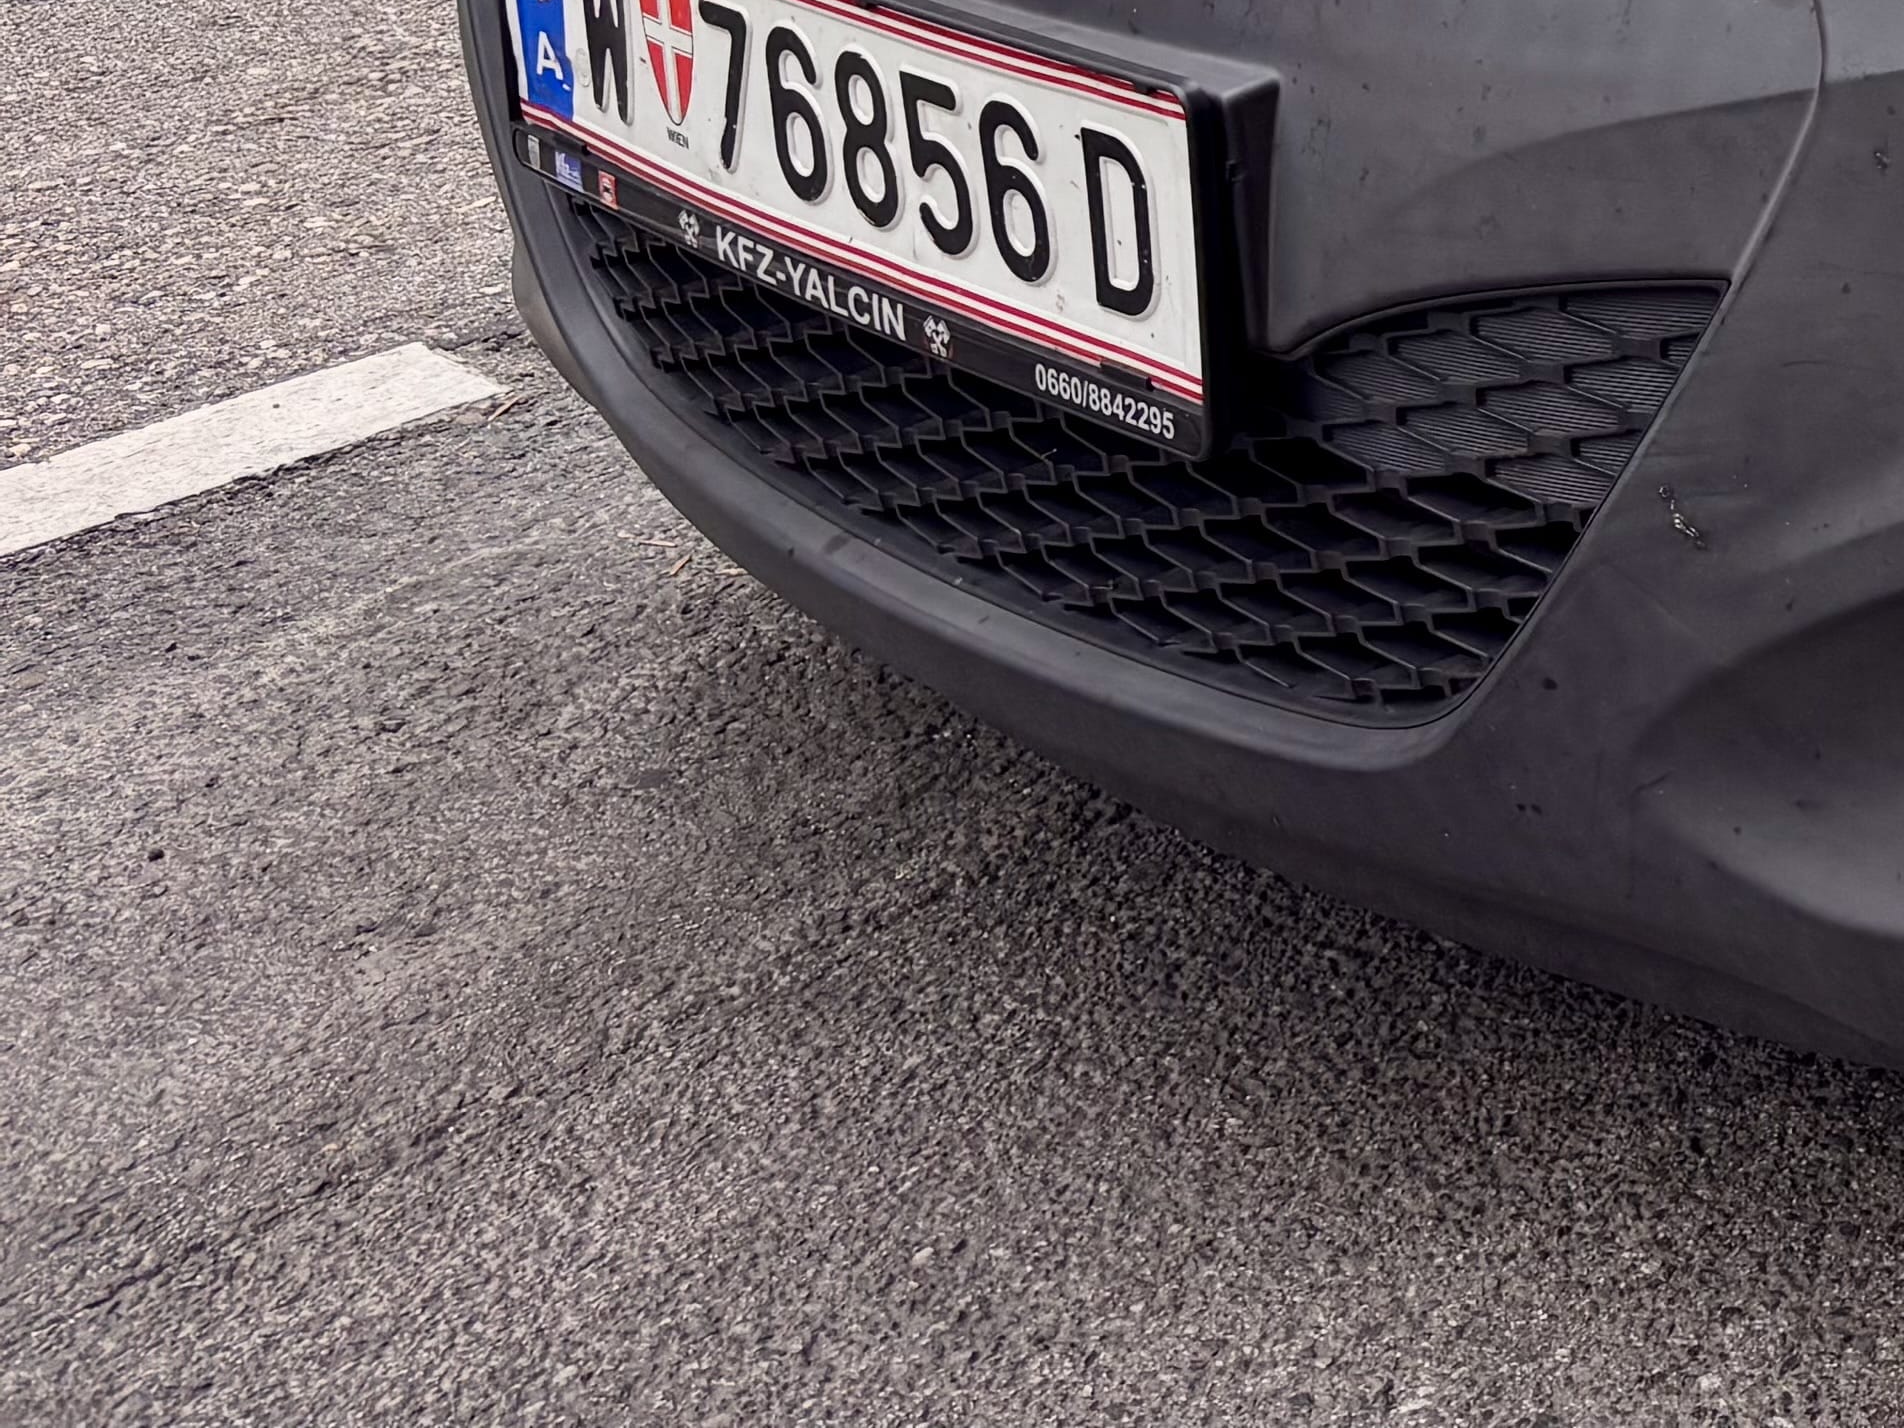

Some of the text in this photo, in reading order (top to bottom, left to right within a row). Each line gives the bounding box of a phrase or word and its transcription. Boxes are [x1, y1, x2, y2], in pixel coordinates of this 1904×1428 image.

[536, 31, 564, 81] A
[715, 225, 906, 341] KFZ-YALCIN
[1035, 363, 1175, 440] 0660/8842295
